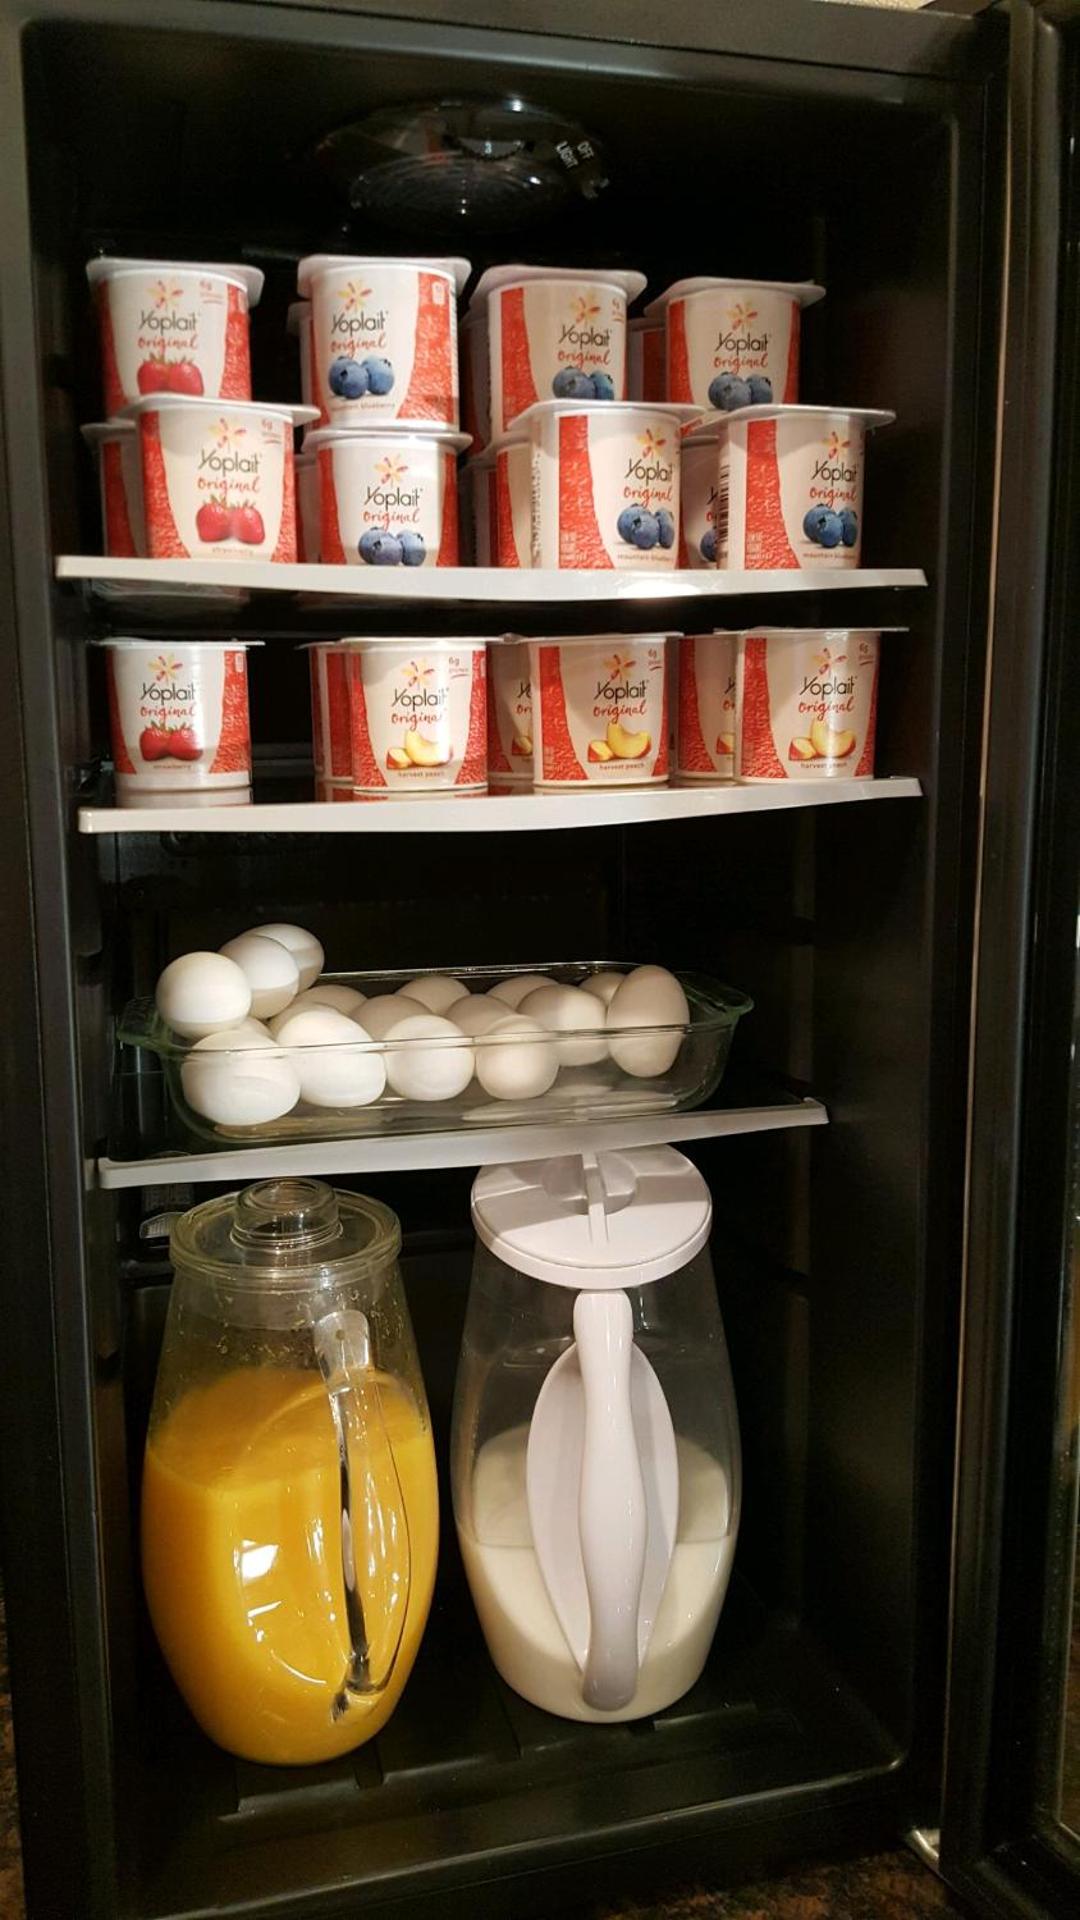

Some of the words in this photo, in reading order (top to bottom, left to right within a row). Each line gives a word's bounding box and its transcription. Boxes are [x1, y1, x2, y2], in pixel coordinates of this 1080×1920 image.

[556, 141, 579, 169] LIGHT
[139, 310, 197, 336] Yoplait
[330, 310, 386, 336] Yoplait
[559, 323, 610, 350] Yoplait
[714, 332, 768, 356] Yoplait
[198, 449, 259, 477] Yoplait
[624, 458, 673, 486] Yoplait
[812, 460, 858, 486] Yoplait
[364, 486, 420, 511] Yoplait
[141, 682, 195, 706] Yoplait
[391, 688, 447, 712] Yoplait
[594, 680, 647, 705] Yoplait
[799, 676, 855, 701] Yoplait
